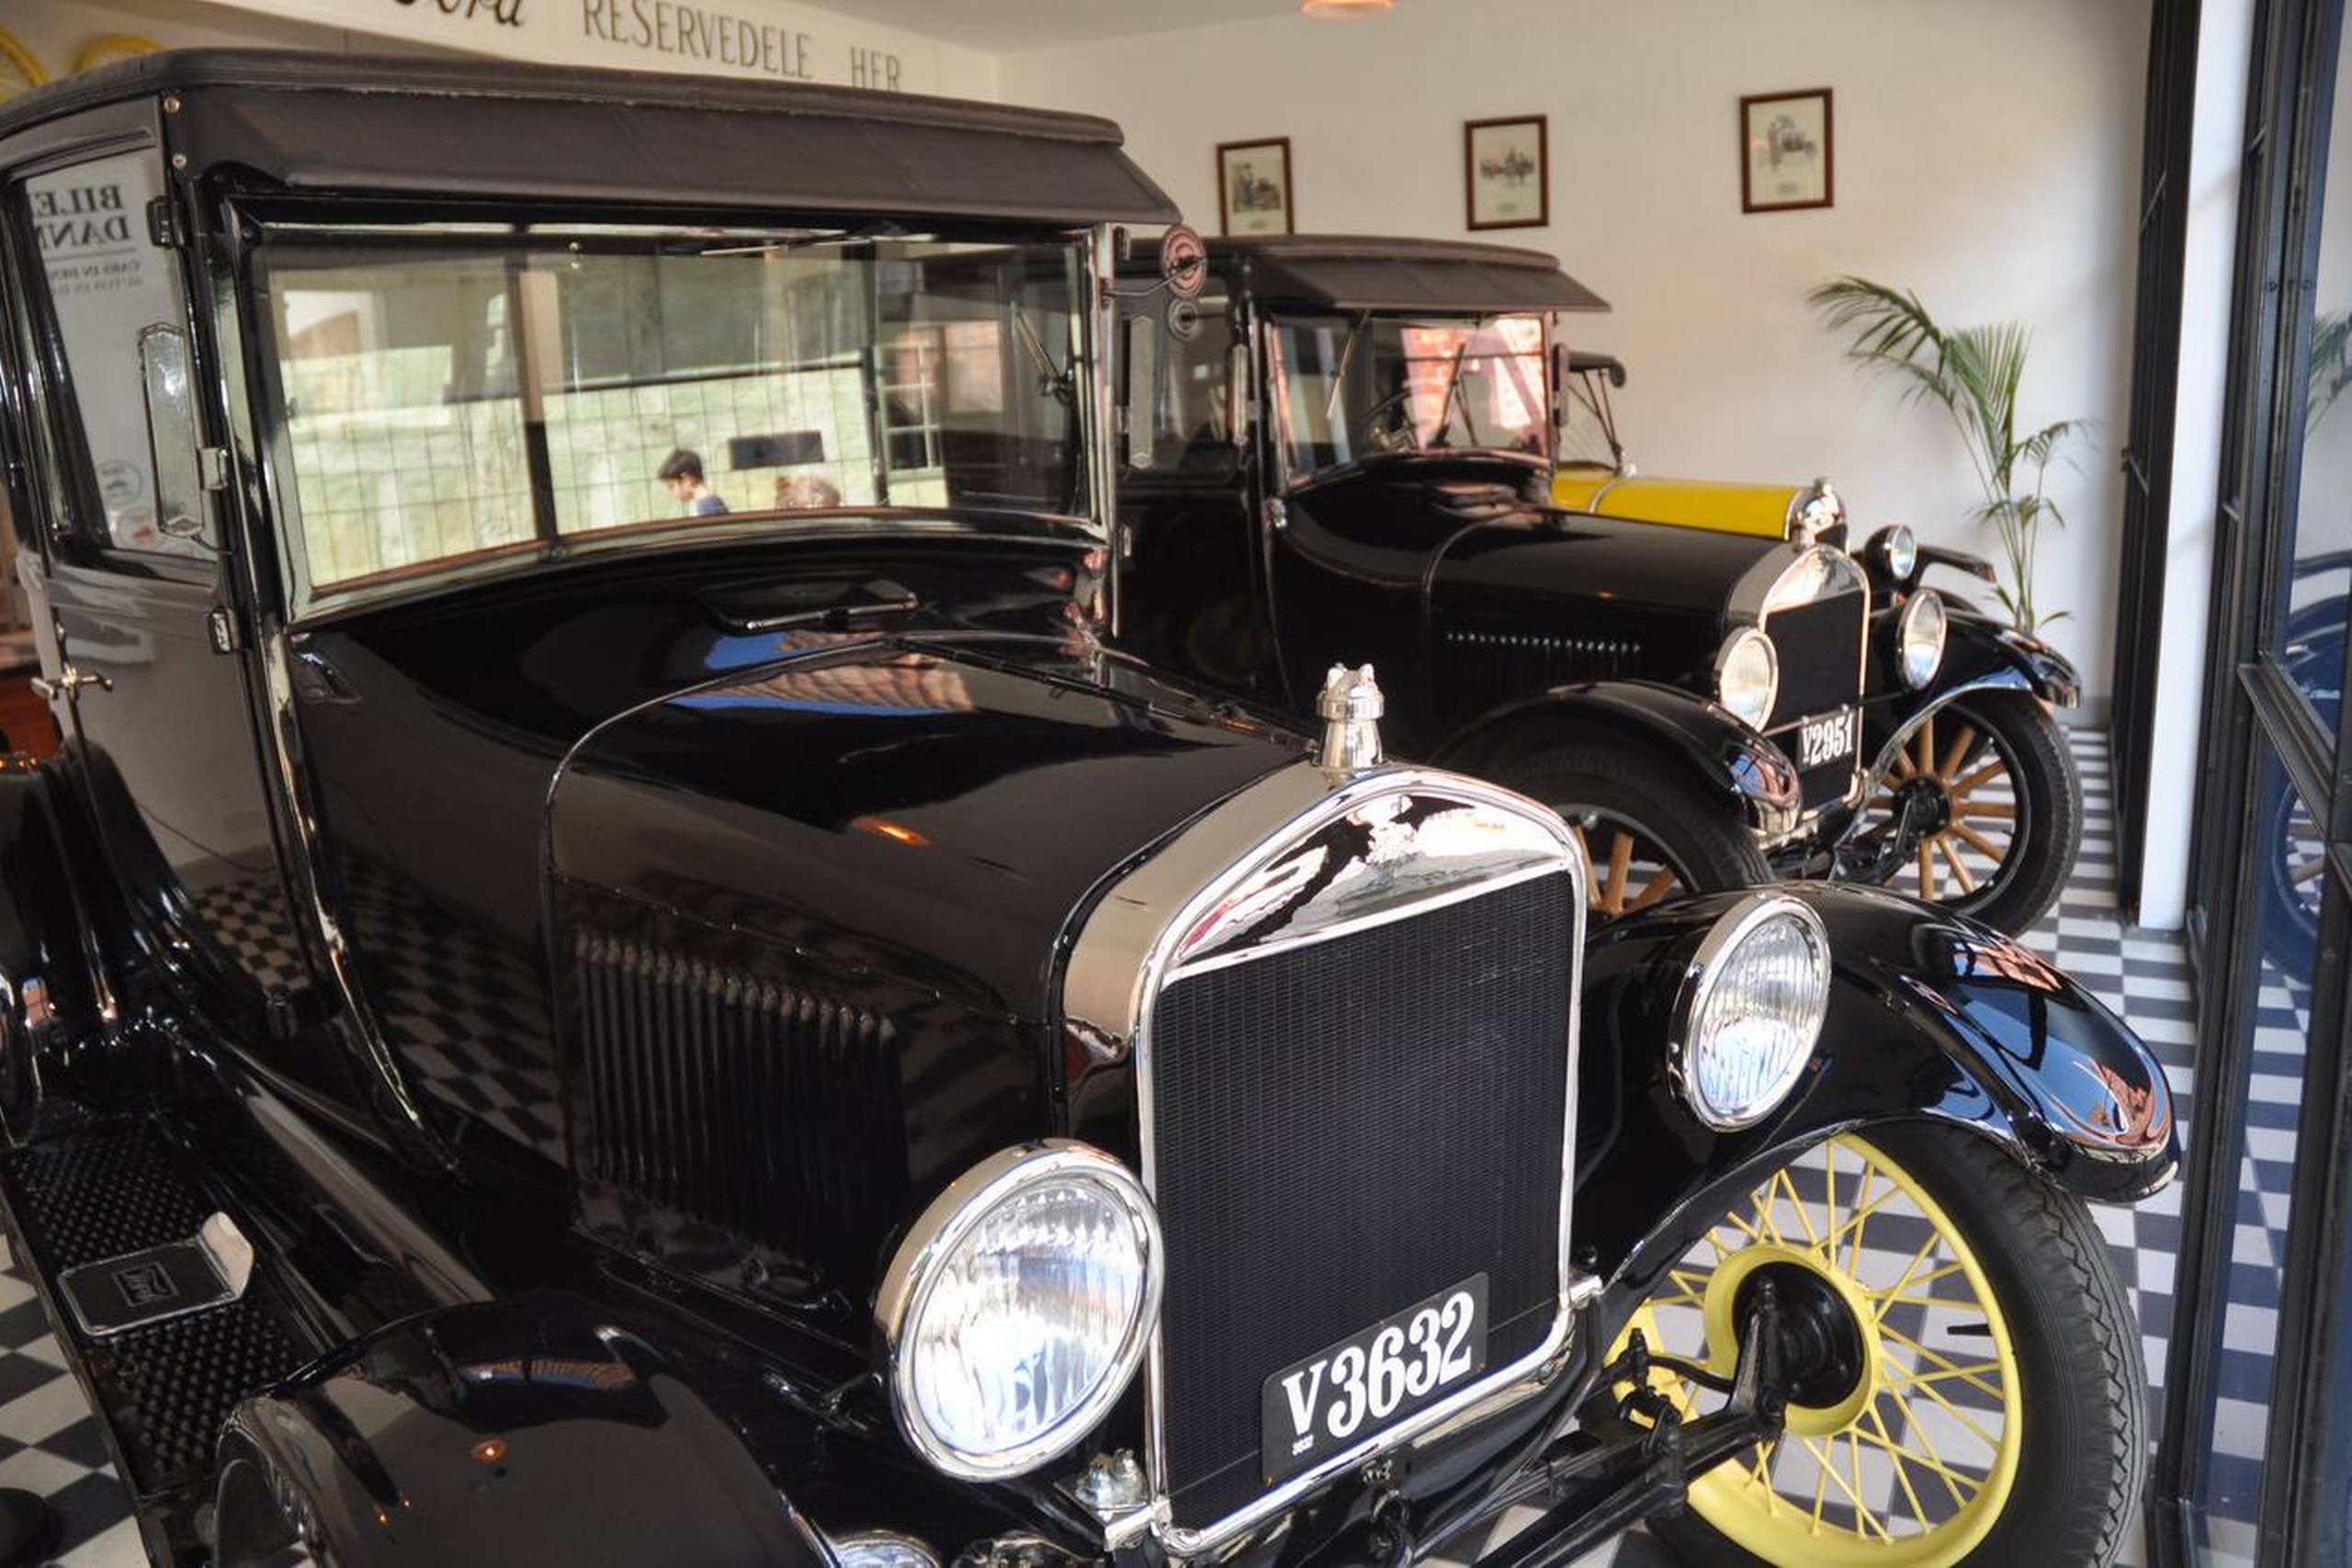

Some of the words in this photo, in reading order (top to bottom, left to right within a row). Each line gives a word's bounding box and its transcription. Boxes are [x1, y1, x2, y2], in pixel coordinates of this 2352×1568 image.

[582, 0, 813, 81] RESERVEDELE
[850, 46, 902, 91] HER
[1281, 1291, 1475, 1438] V3632
